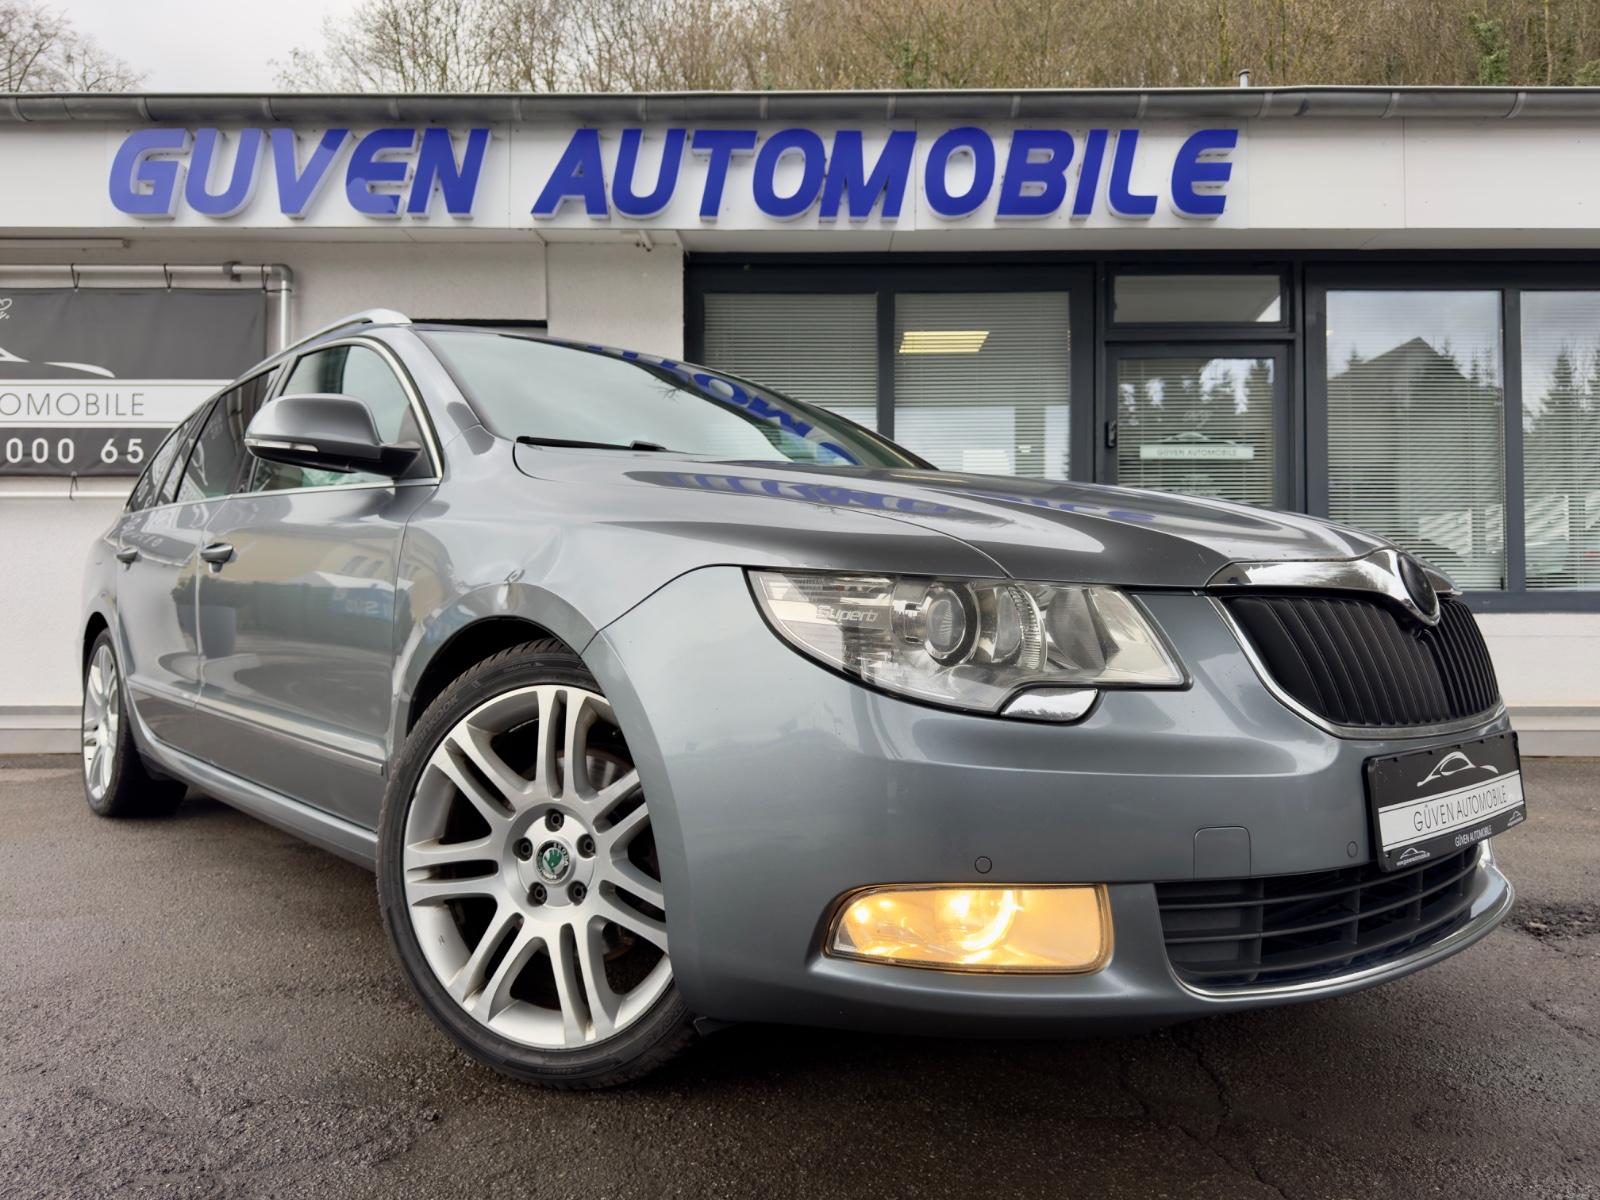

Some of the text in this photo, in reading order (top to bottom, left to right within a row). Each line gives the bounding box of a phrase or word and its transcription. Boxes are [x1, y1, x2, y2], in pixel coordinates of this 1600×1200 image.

[530, 126, 1239, 222] AUTOMOBILE
[5, 437, 145, 464] 000 65
[1187, 448, 1237, 457] AUTOMOBILE
[815, 604, 879, 623] Superb
[1413, 785, 1508, 832] GÜVEN AUTOMOBILE
[1470, 824, 1493, 843] AUTOMOBILE
